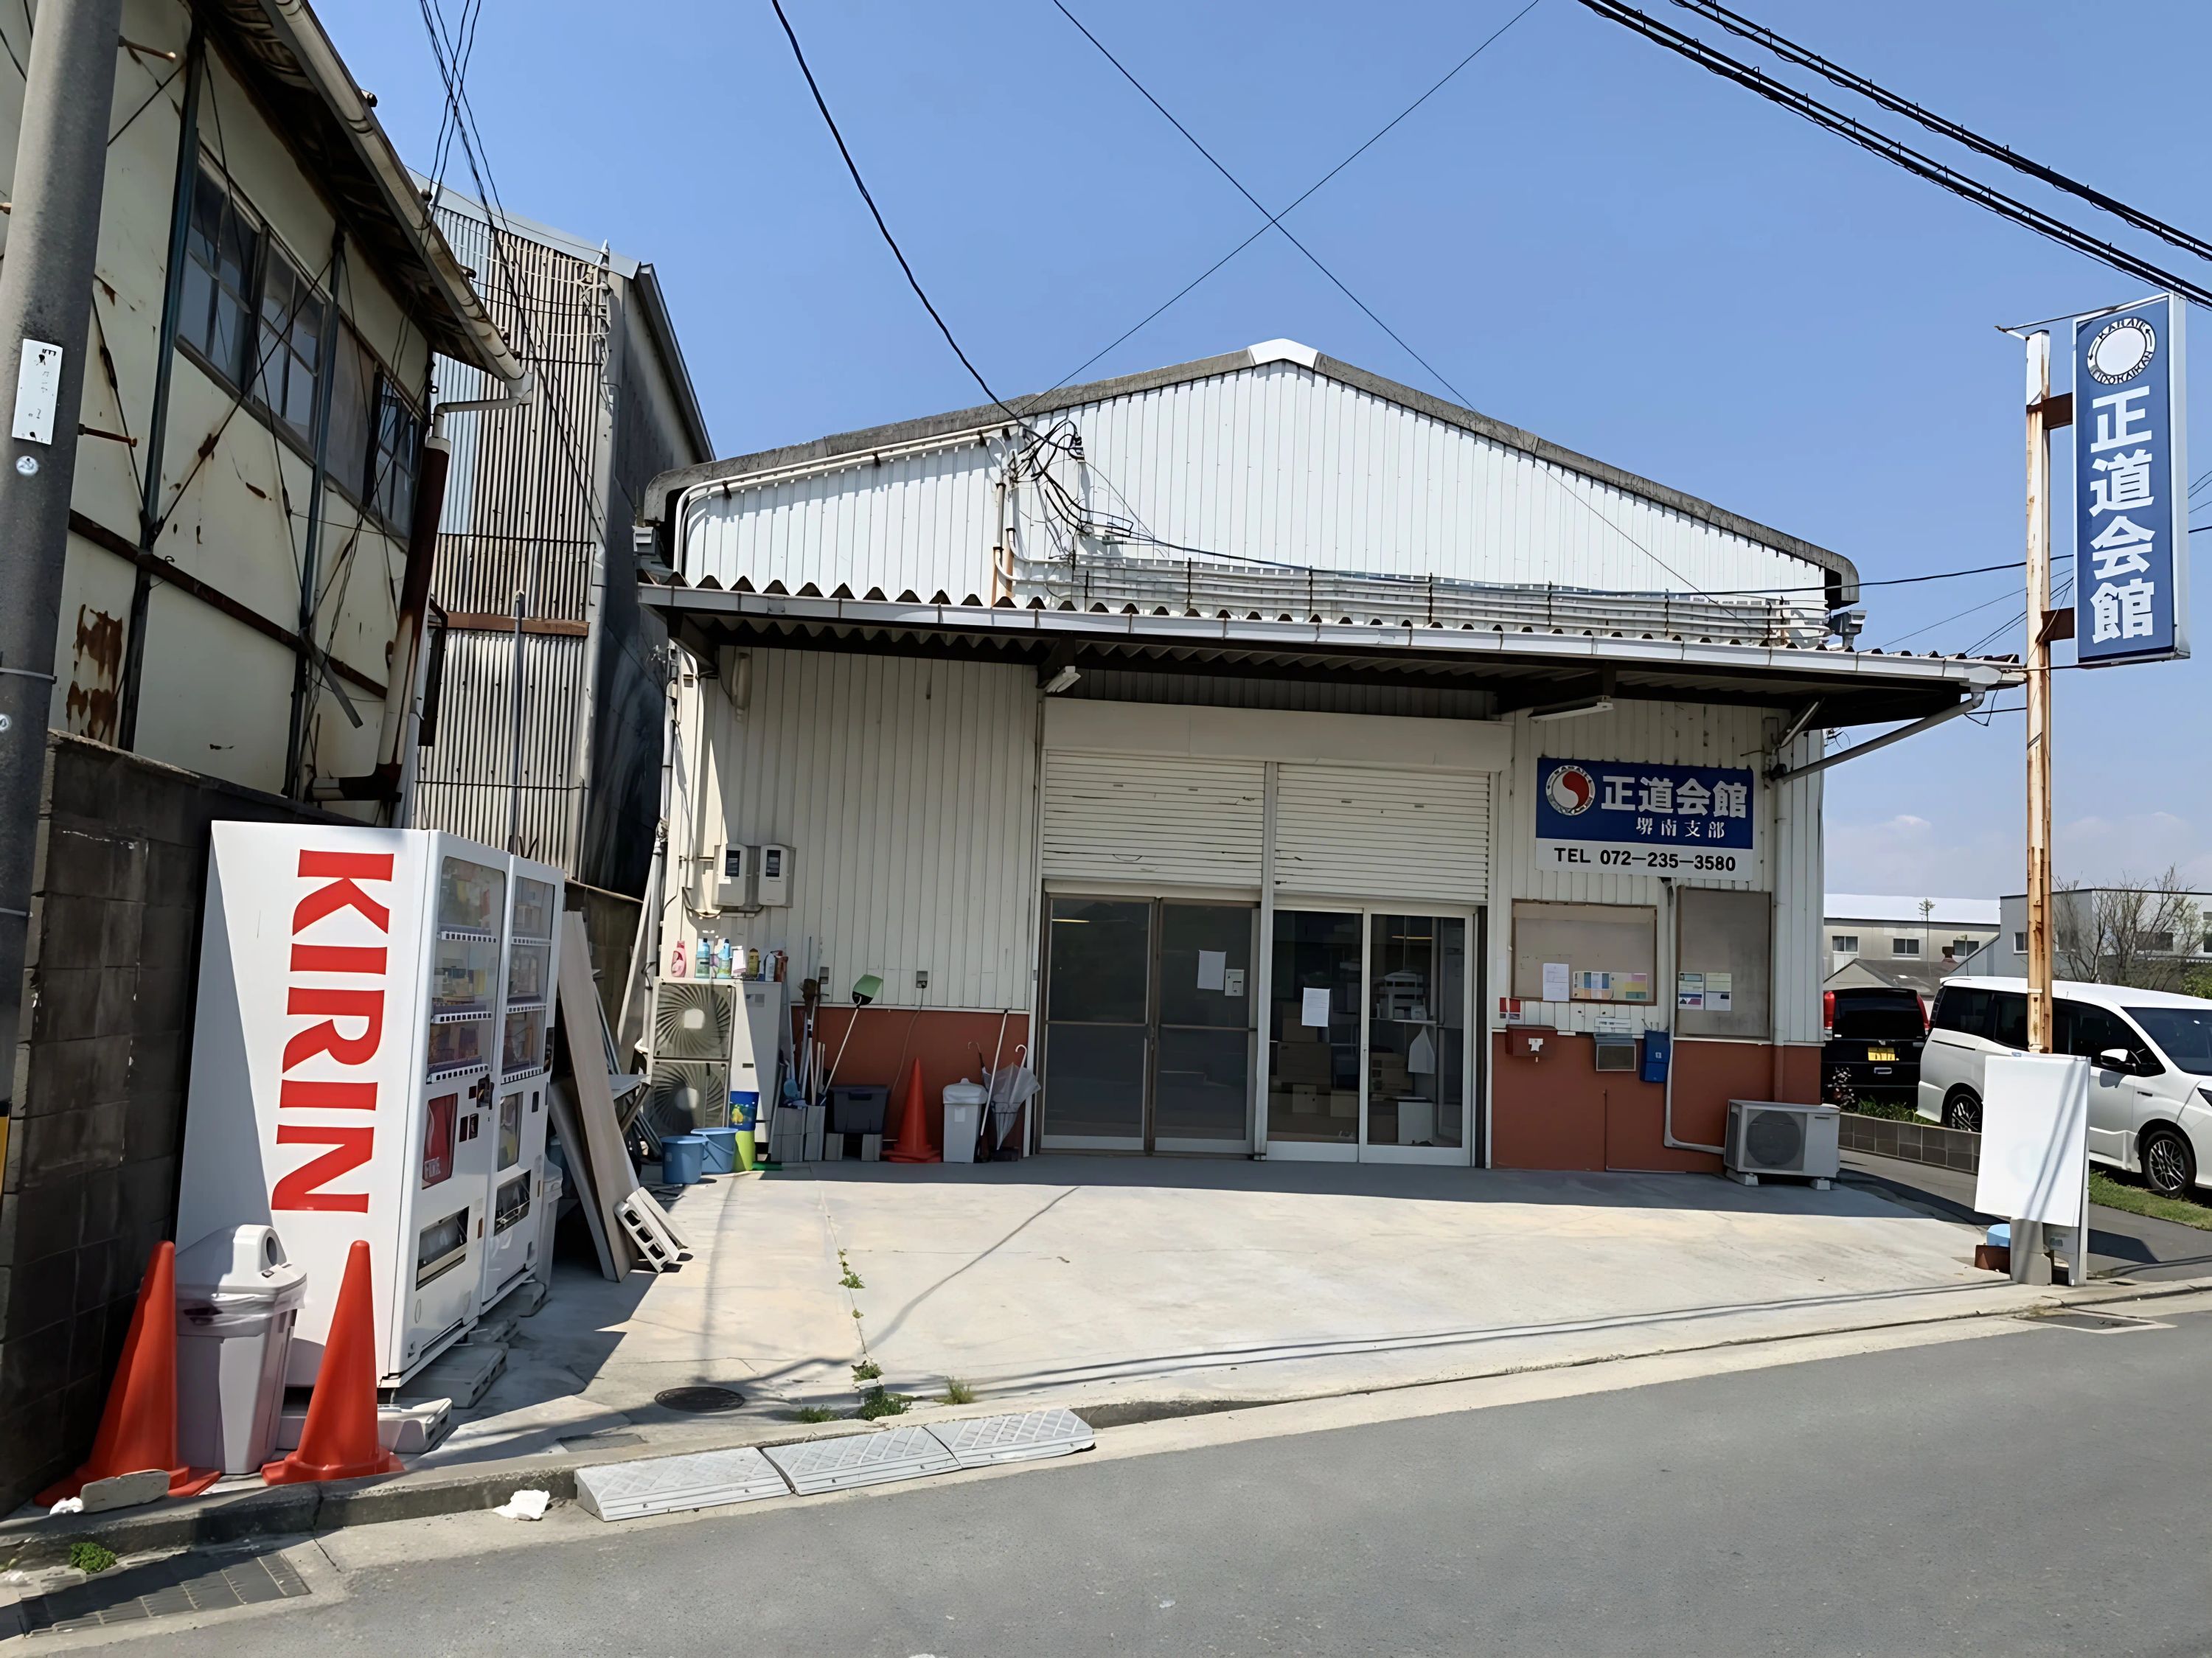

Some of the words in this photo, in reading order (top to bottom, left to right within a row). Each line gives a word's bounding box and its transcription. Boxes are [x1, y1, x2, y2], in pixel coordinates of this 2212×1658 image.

[2089, 386, 2155, 644] 正道会館
[1554, 847, 1591, 864] TEL
[1601, 776, 1747, 818] 正道会館
[271, 849, 395, 1214] KIRIN
